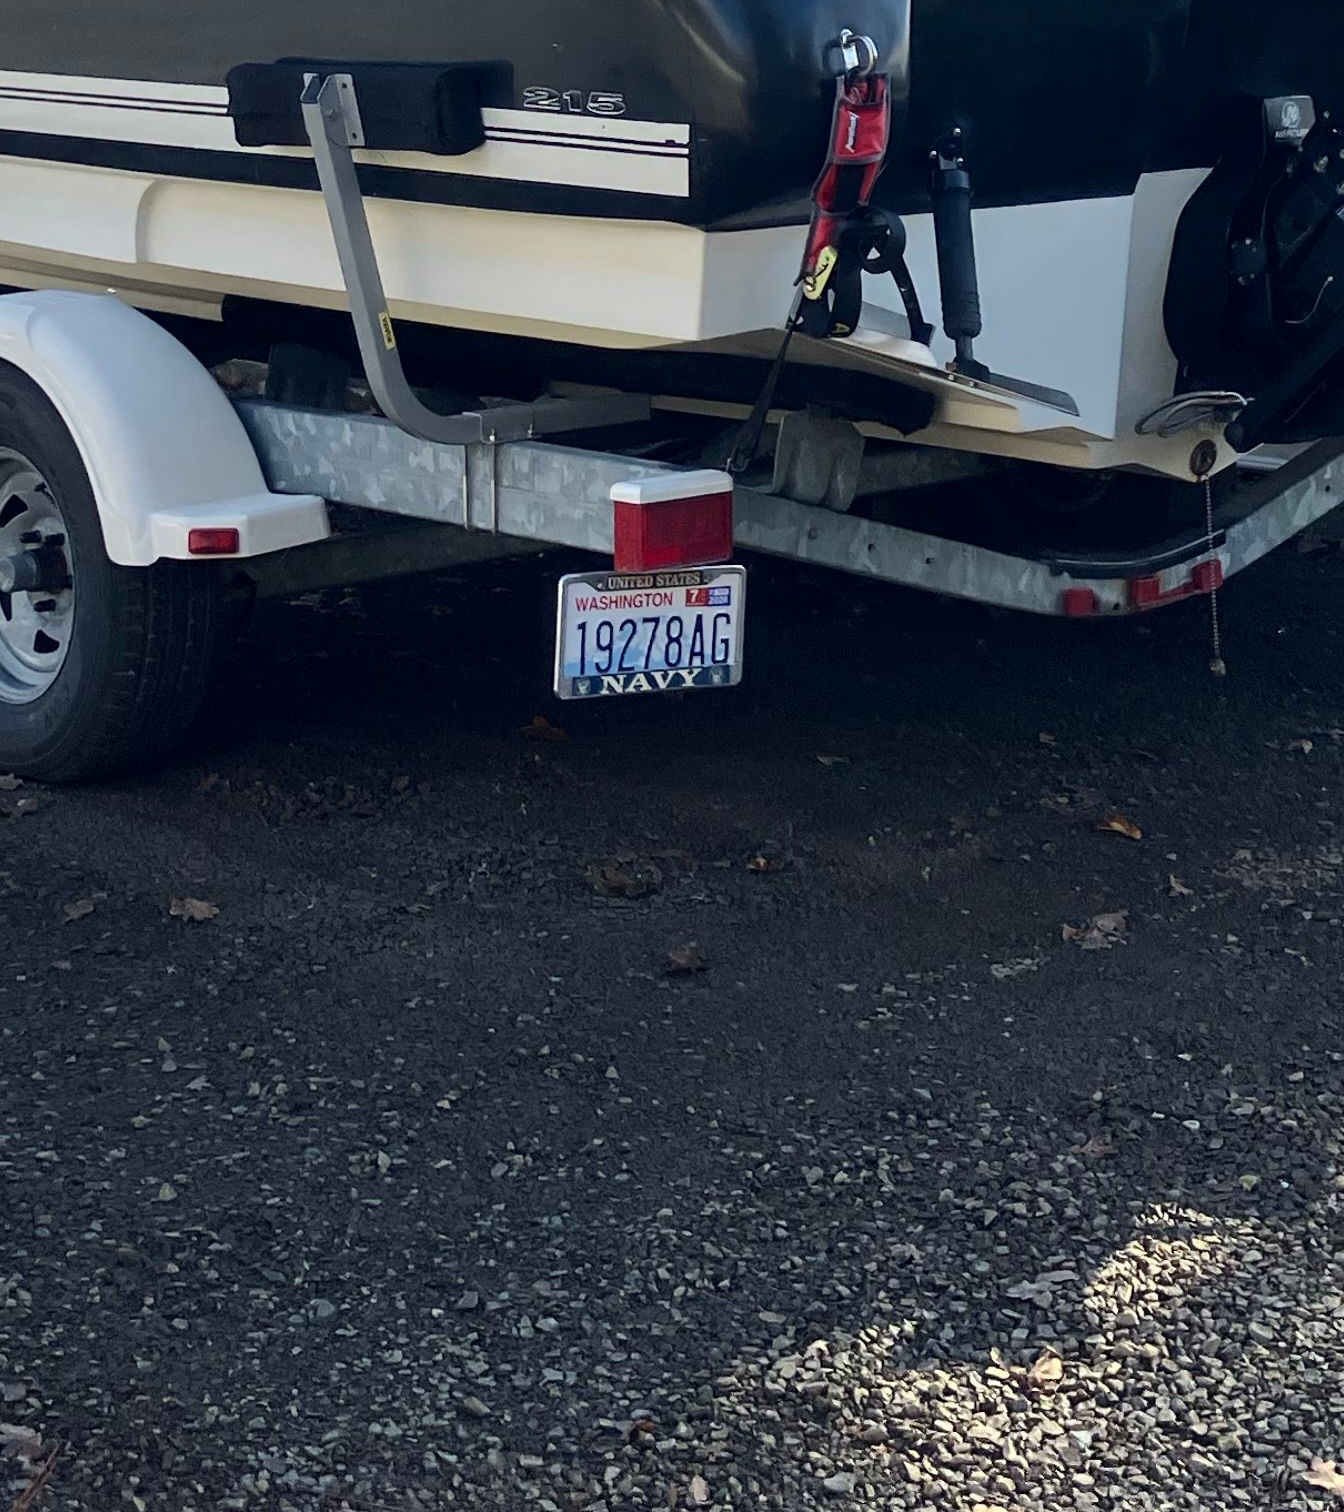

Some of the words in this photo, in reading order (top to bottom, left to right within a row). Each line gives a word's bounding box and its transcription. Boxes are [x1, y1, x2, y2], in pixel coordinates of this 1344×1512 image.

[523, 86, 627, 116] 215
[608, 574, 652, 589] UNITED
[656, 572, 701, 587] STATES
[575, 592, 674, 612] WASHINGTON
[689, 589, 699, 602] 7
[577, 612, 731, 675] 19278AG
[600, 668, 702, 694] NAVY
